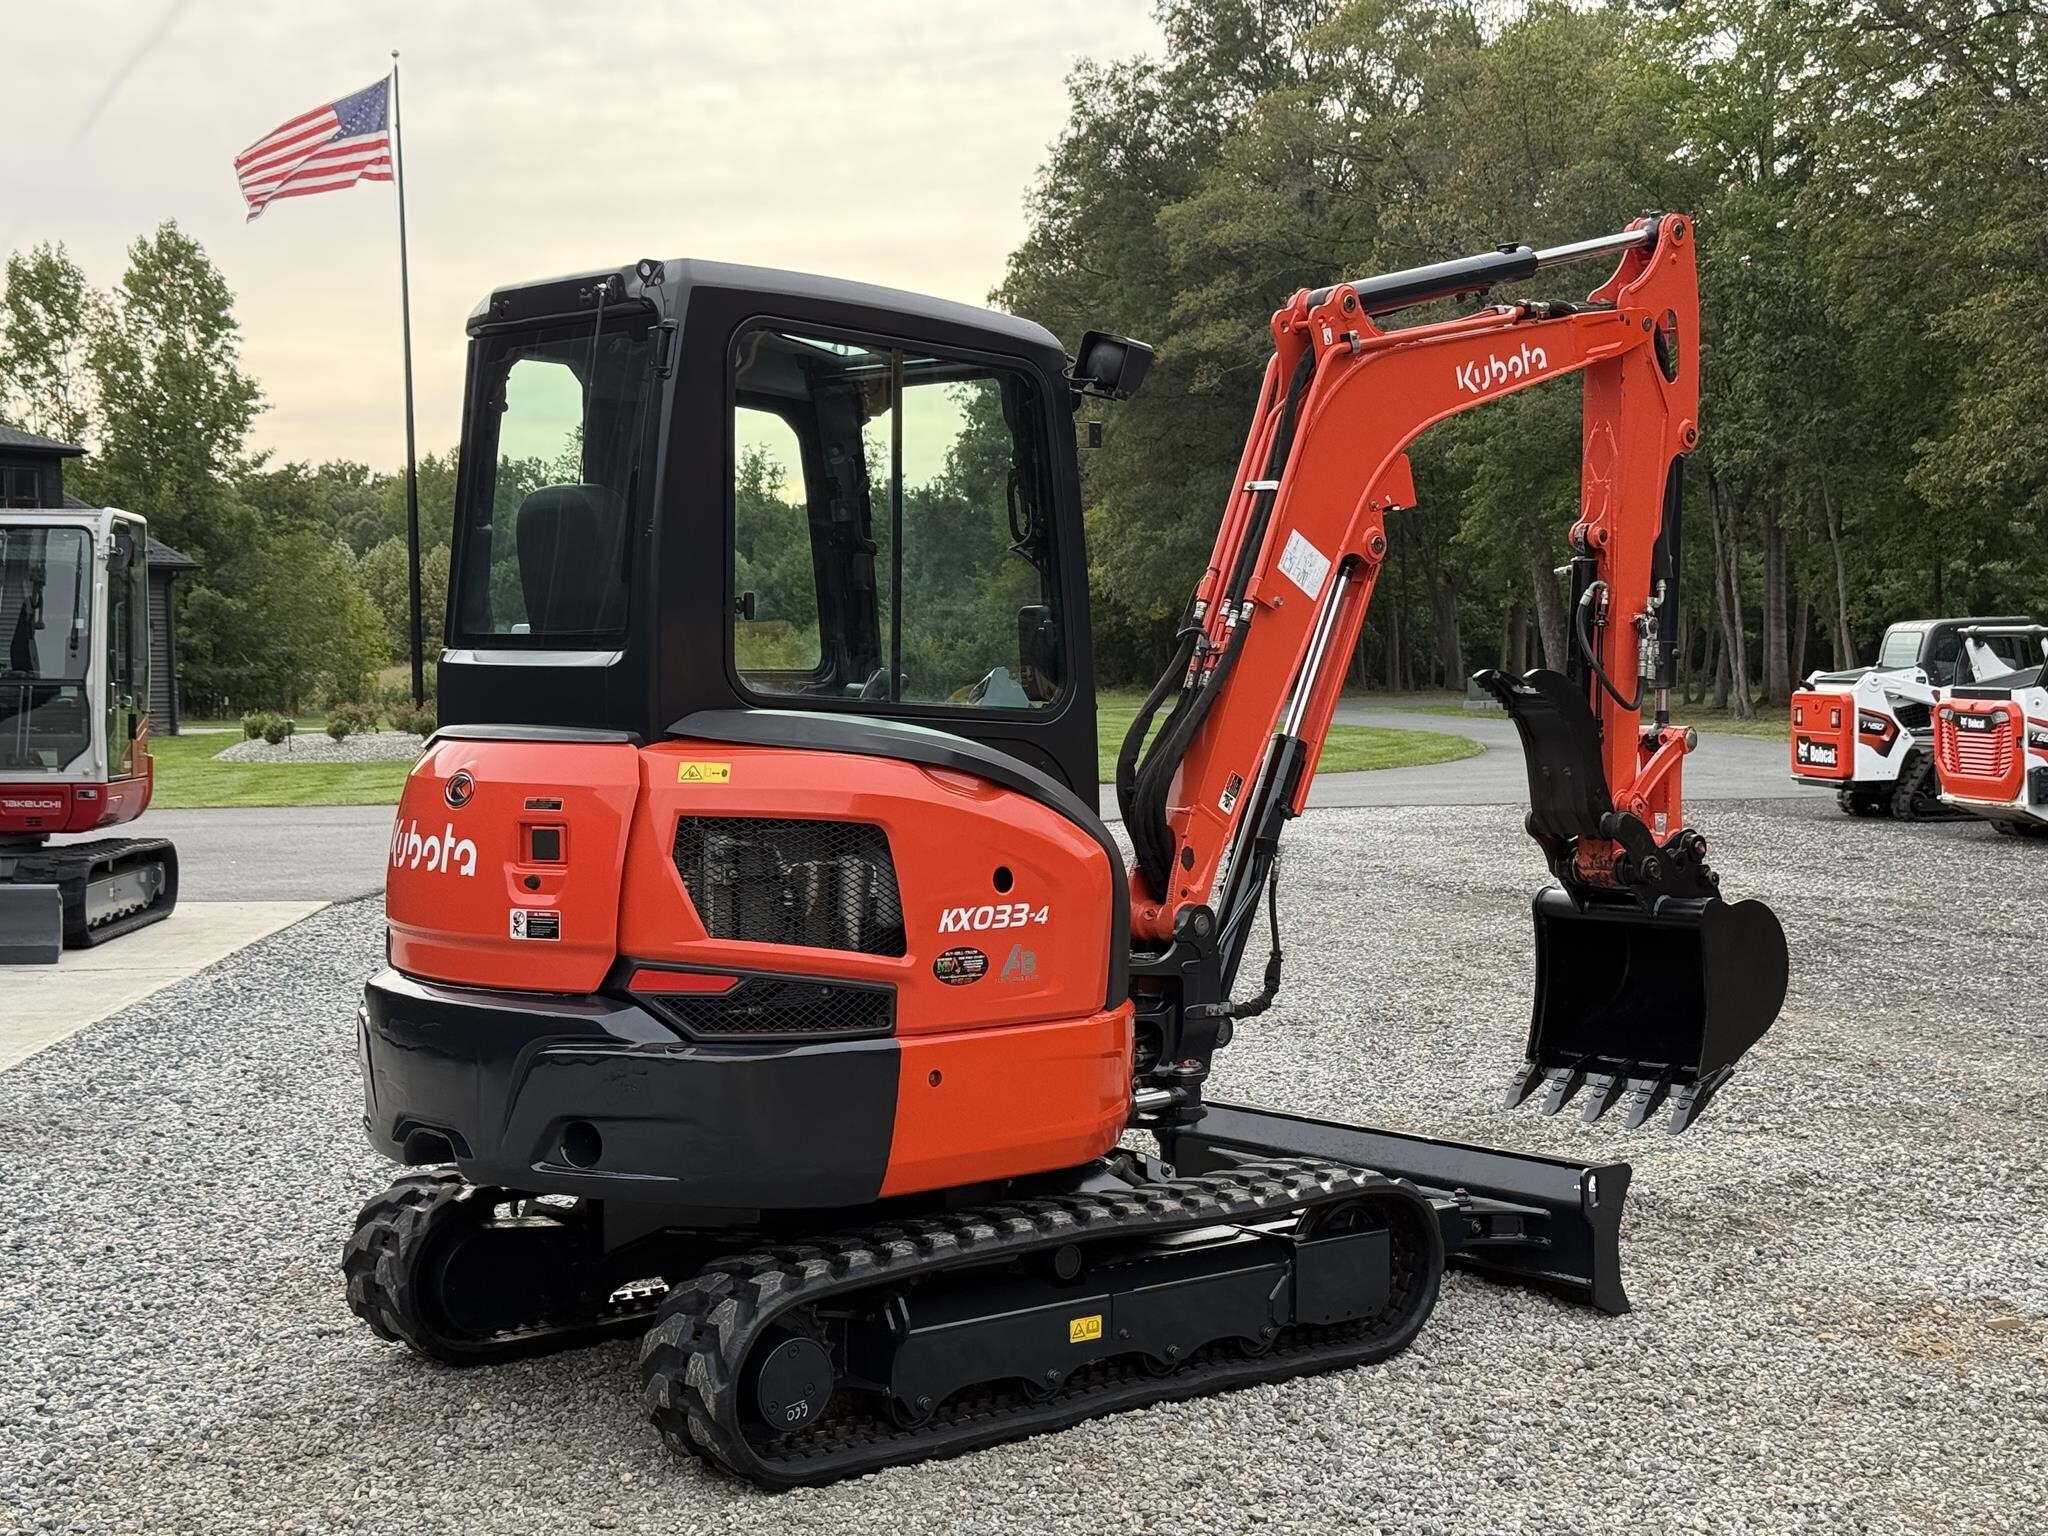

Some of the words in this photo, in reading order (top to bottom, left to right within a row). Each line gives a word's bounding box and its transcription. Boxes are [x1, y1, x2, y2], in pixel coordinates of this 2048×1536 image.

[1455, 342, 1548, 394] Kubota
[1809, 745, 1837, 764] Bobcat
[391, 818, 478, 877] Kubota
[937, 903, 1050, 934] KX033-4
